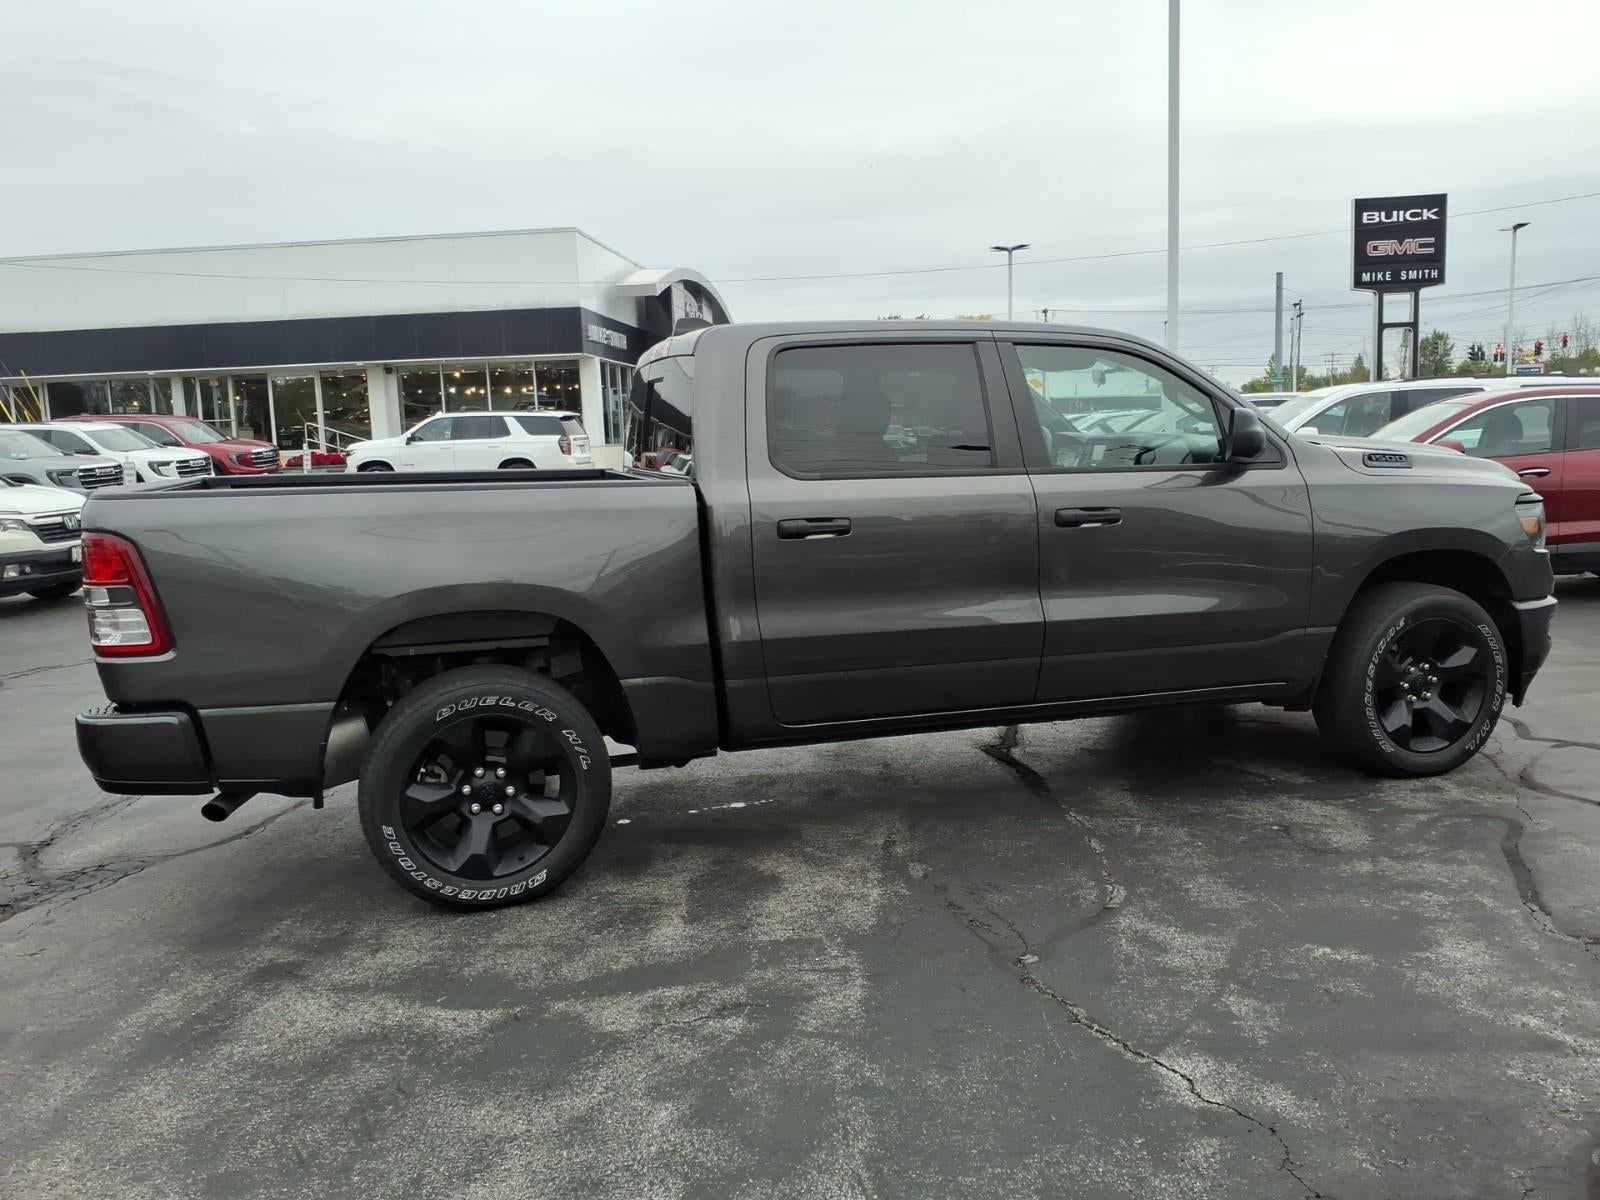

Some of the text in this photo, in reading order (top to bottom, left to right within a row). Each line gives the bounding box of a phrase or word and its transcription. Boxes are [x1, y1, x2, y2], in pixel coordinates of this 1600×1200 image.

[1362, 208, 1440, 223] BUICK
[1366, 237, 1435, 256] GMC
[1361, 268, 1438, 282] MIKE SMITH
[436, 695, 592, 770] DUELER H/L
[382, 824, 549, 901] BRIDGESTONE
